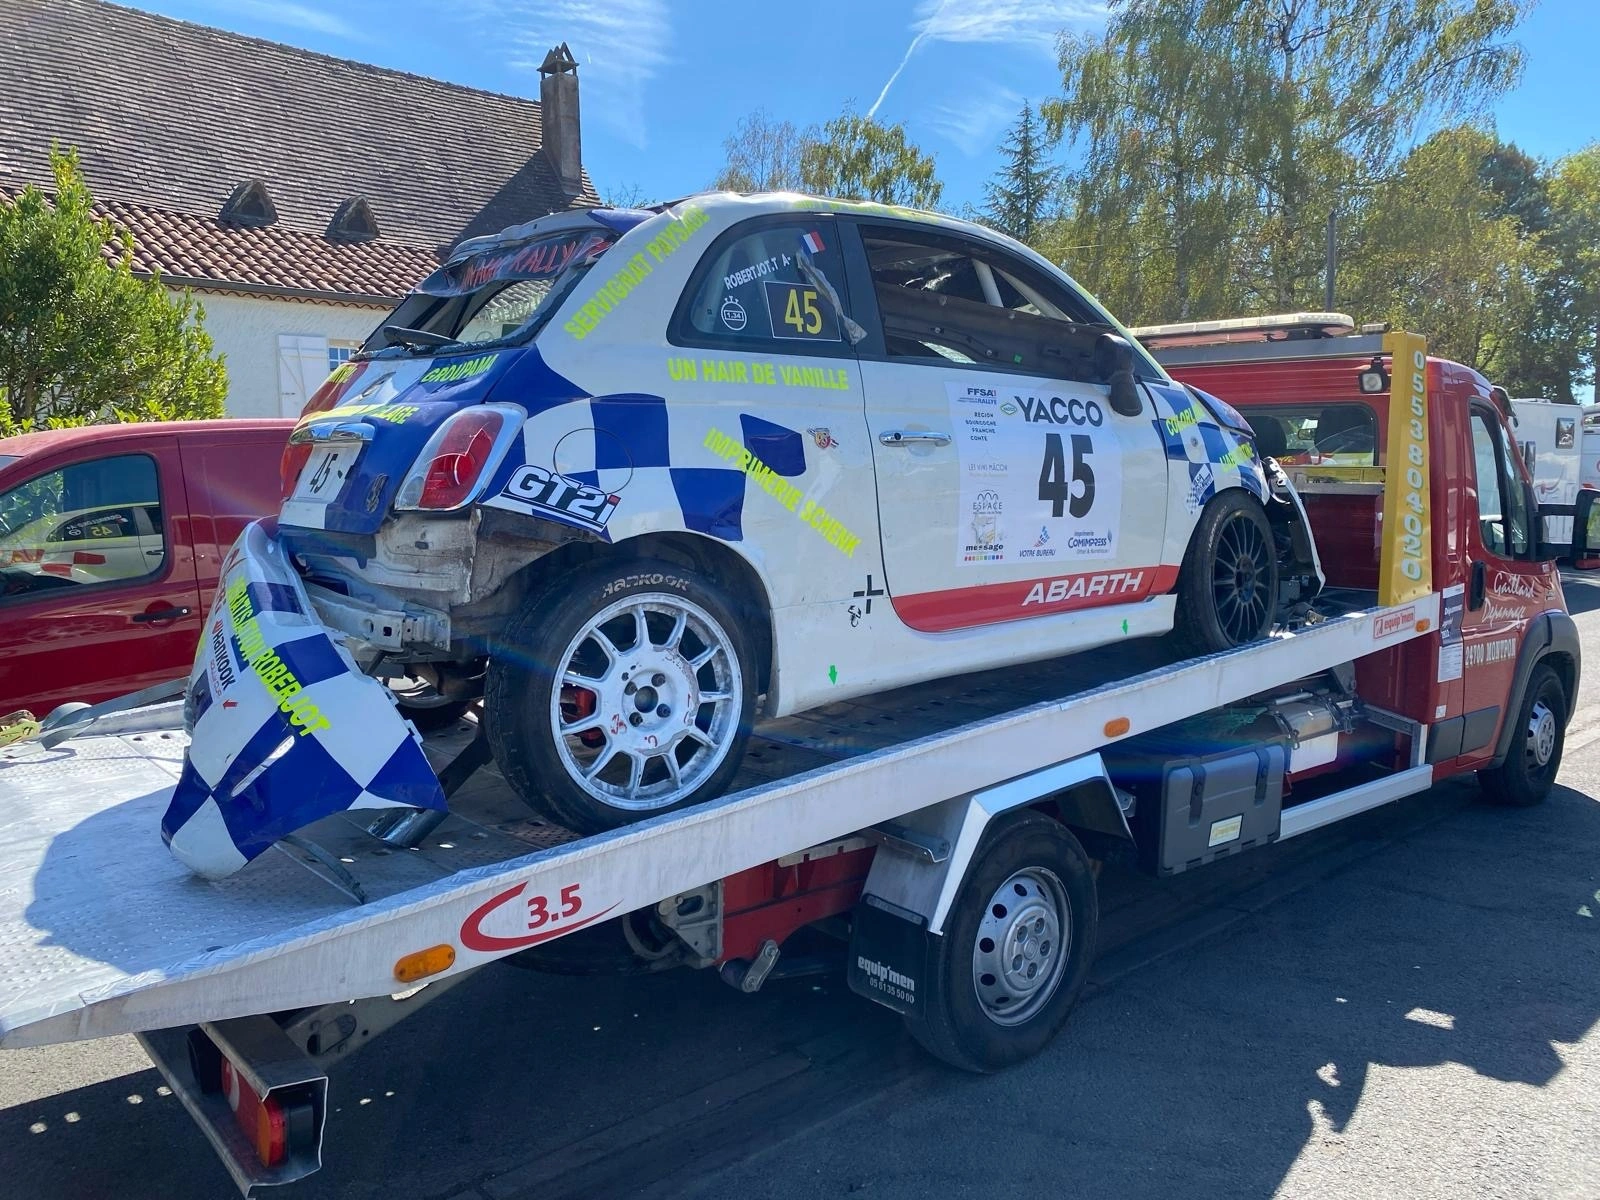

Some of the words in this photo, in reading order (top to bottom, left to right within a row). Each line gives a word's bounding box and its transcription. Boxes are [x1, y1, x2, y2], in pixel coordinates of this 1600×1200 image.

[645, 203, 710, 265] PAYSAGE
[784, 288, 823, 335] 45
[420, 353, 499, 383] GROUPAMA
[667, 358, 697, 382] UN
[702, 359, 748, 384] HAIR
[752, 362, 777, 385] DE
[780, 365, 849, 390] VANILLE
[967, 387, 993, 397] FFSA
[1014, 396, 1103, 427] YACCO
[310, 452, 338, 494] 45
[703, 427, 805, 513] IMPRIMERIE
[799, 499, 862, 558] SCHENK
[1038, 432, 1096, 519] 45
[505, 466, 621, 530] GT2i
[972, 501, 1003, 510] ESPACE
[1021, 571, 1143, 607] ABARTH
[252, 648, 332, 737] ROBERJOT
[527, 883, 582, 930] 3.5
[869, 977, 878, 988] 05
